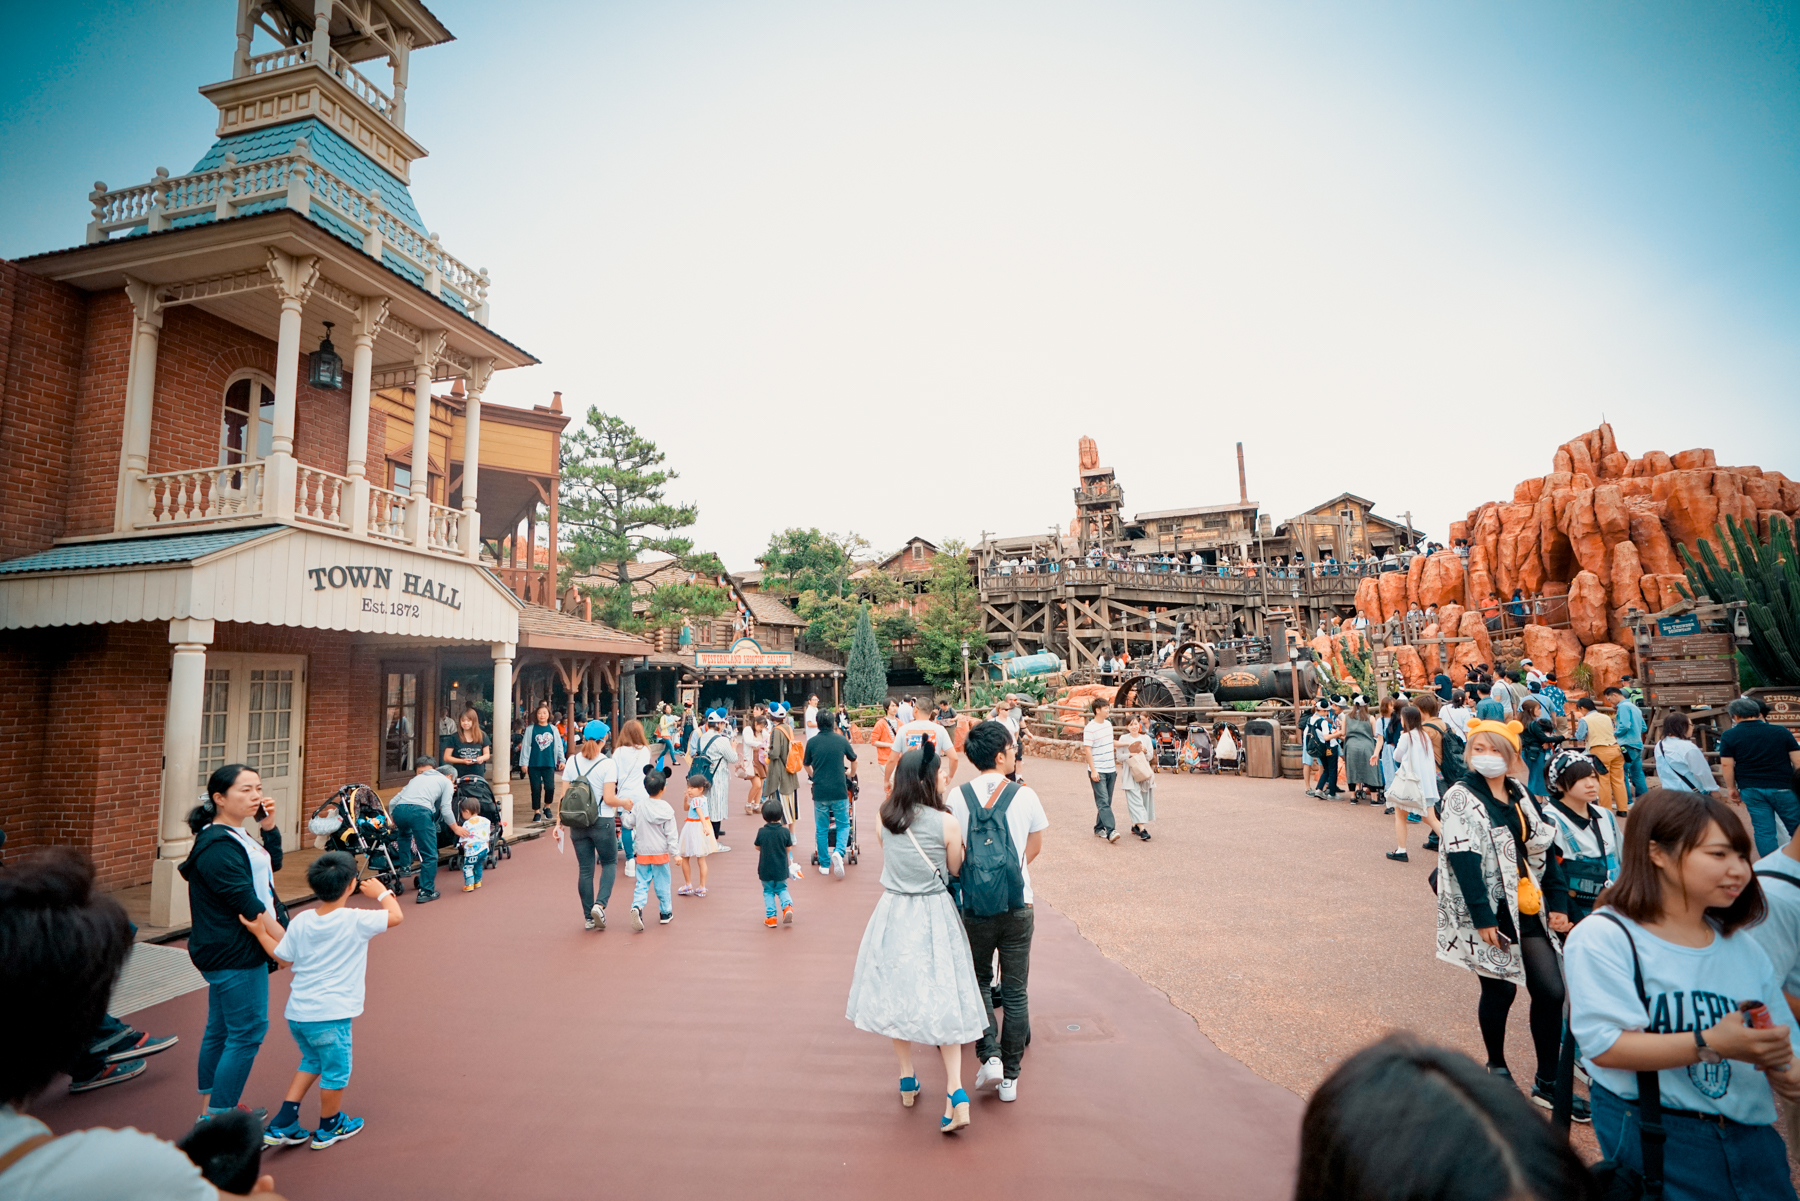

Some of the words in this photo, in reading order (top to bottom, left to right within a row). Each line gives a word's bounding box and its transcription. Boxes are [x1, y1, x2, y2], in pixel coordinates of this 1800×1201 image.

[308, 566, 393, 591] TOWN
[402, 572, 462, 611] HALL
[361, 597, 388, 615] Est.
[390, 602, 420, 618] 1872
[701, 654, 742, 664] WESTERNLAND
[766, 655, 788, 664] GALLERY
